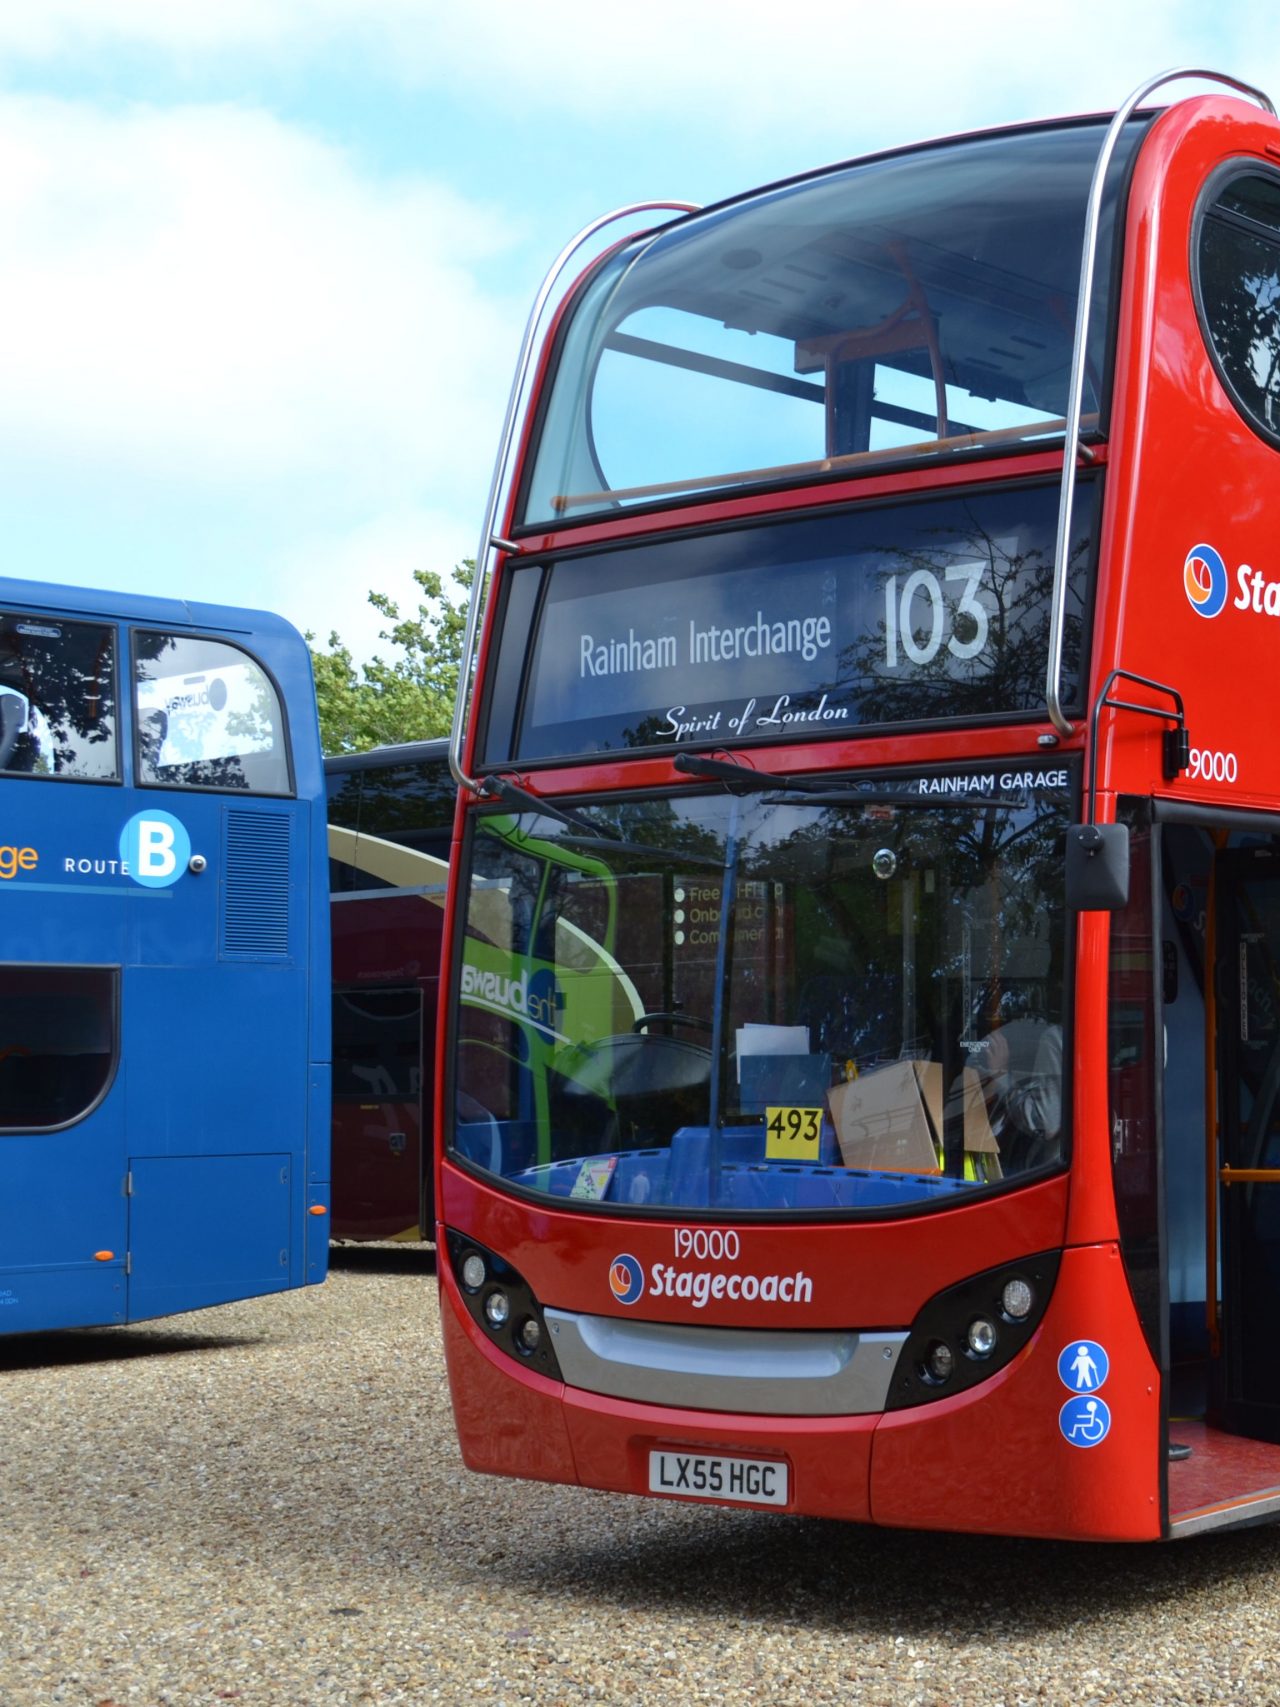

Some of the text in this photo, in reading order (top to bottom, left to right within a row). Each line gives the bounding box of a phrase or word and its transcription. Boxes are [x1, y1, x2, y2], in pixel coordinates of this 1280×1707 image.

[886, 561, 988, 668] 103
[581, 611, 831, 677] Rainham Interchange
[656, 694, 849, 741] Spirit of London
[919, 770, 1068, 795] RAINHAM GARAGE
[65, 820, 176, 877] ROUTE B
[768, 1109, 819, 1141] 493
[674, 1228, 740, 1260] 19000
[649, 1263, 812, 1308] Stagecoach
[660, 1456, 776, 1497] LX55 HGC
